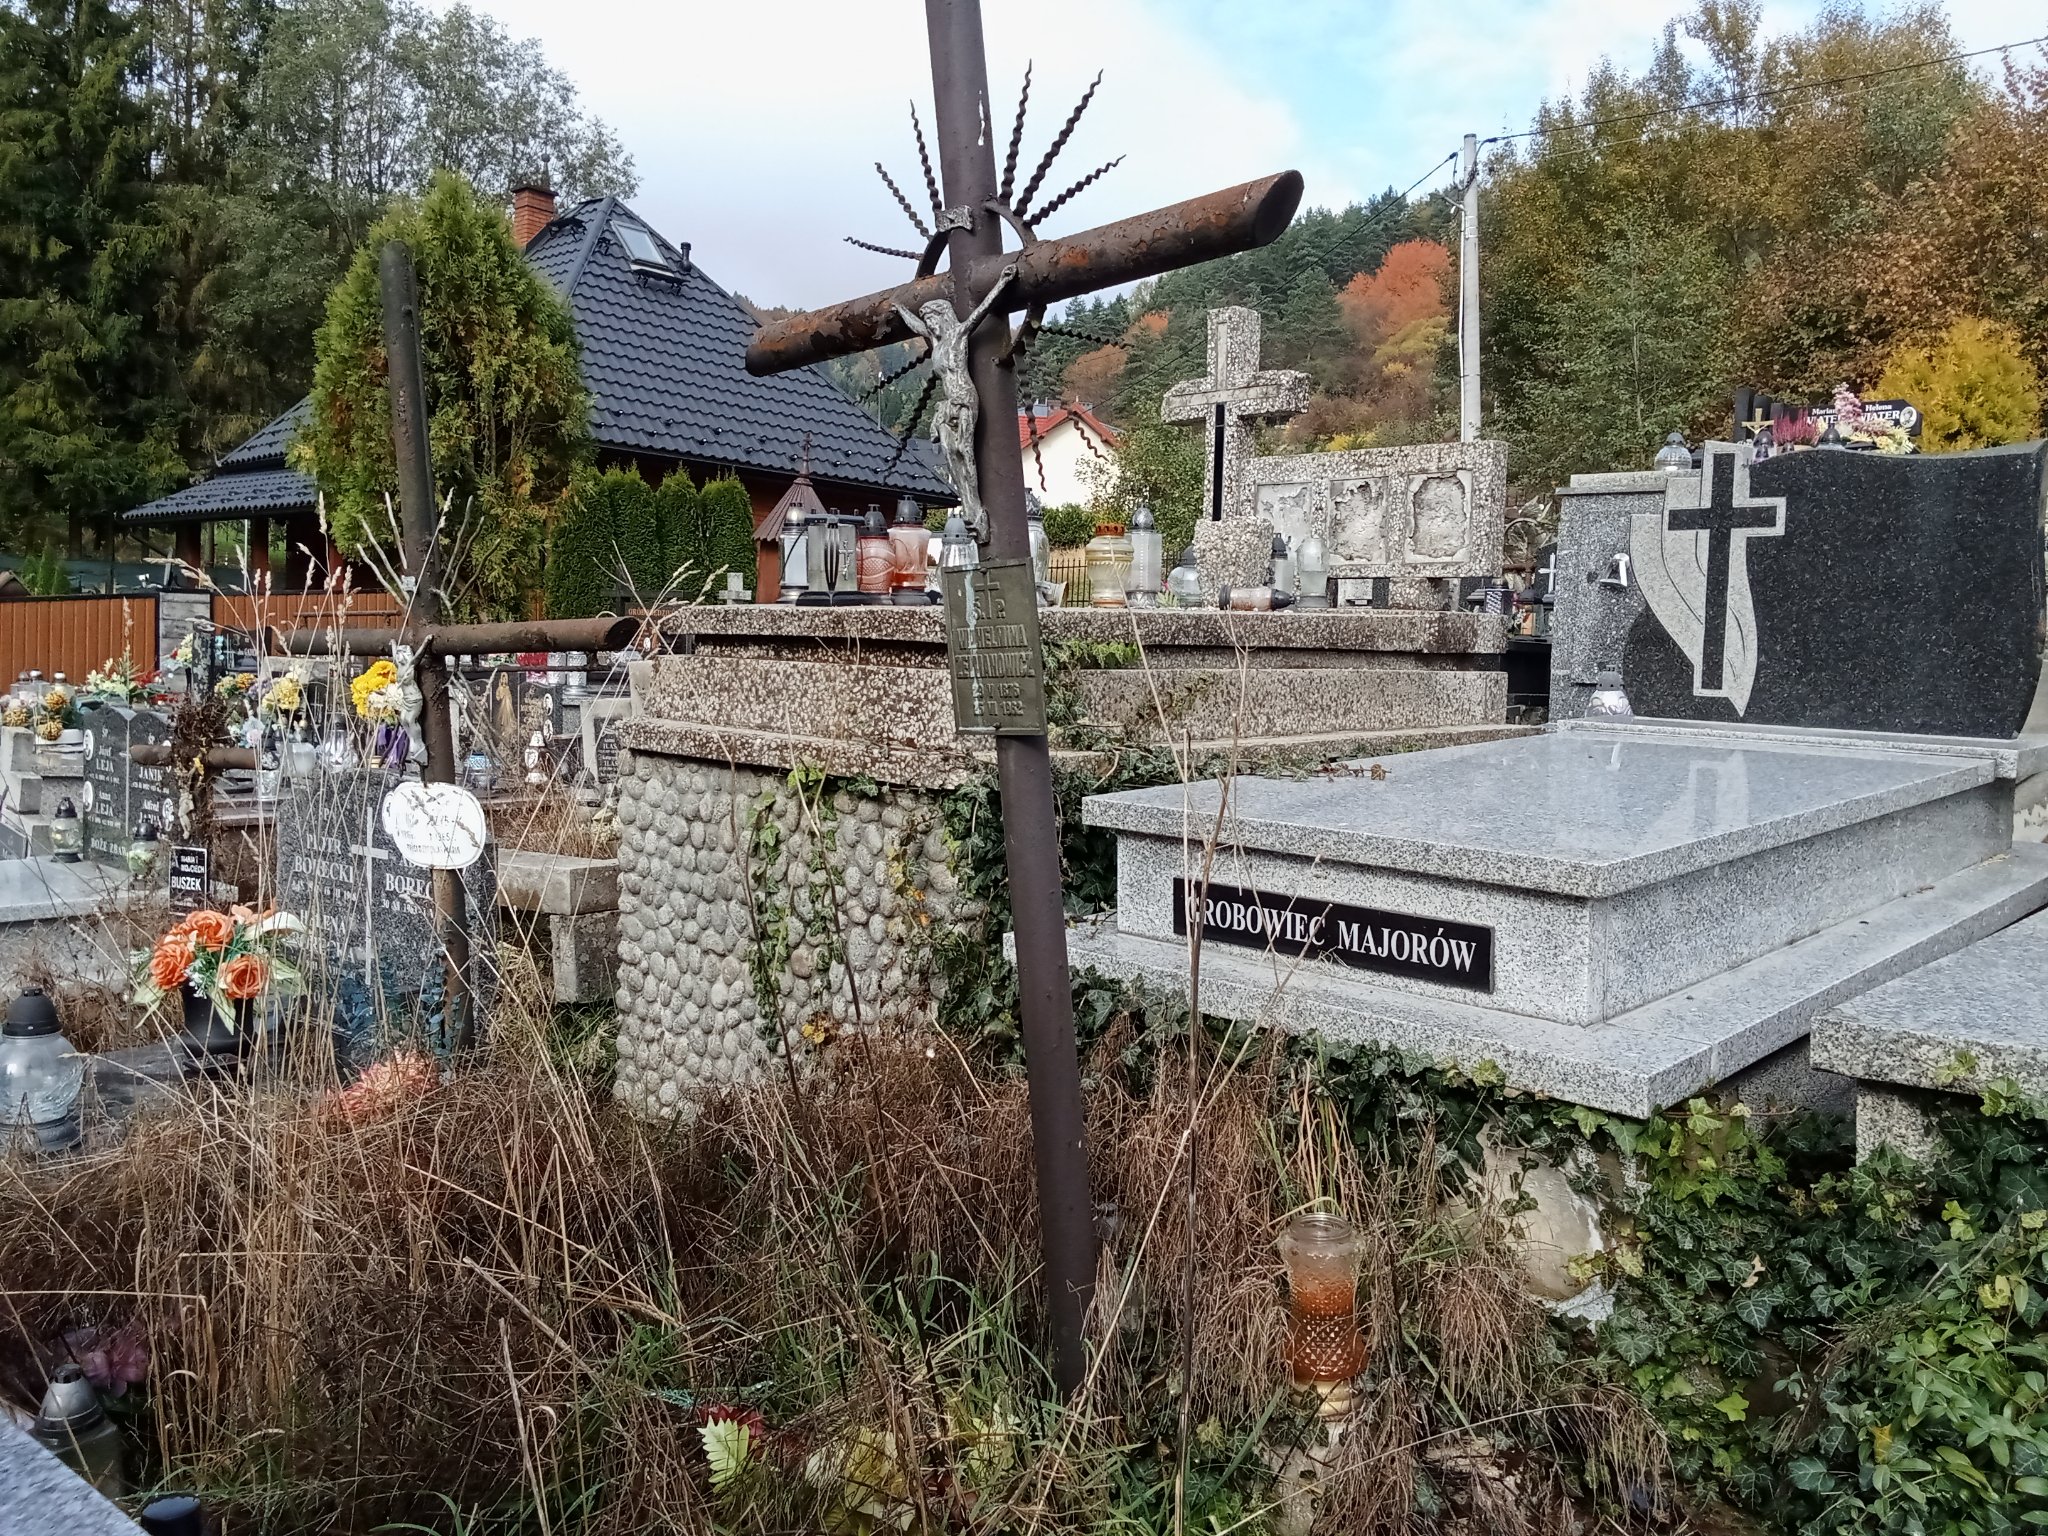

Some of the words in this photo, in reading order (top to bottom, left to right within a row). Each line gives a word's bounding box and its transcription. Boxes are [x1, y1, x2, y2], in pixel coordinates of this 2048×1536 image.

[95, 757, 115, 773] LEJA
[95, 801, 114, 817] LEJA
[171, 876, 202, 891] BUSZEK
[385, 872, 433, 901] BOREC
[1187, 896, 1326, 946] GROBOWIEC
[1336, 919, 1477, 973] MAJORÓW
